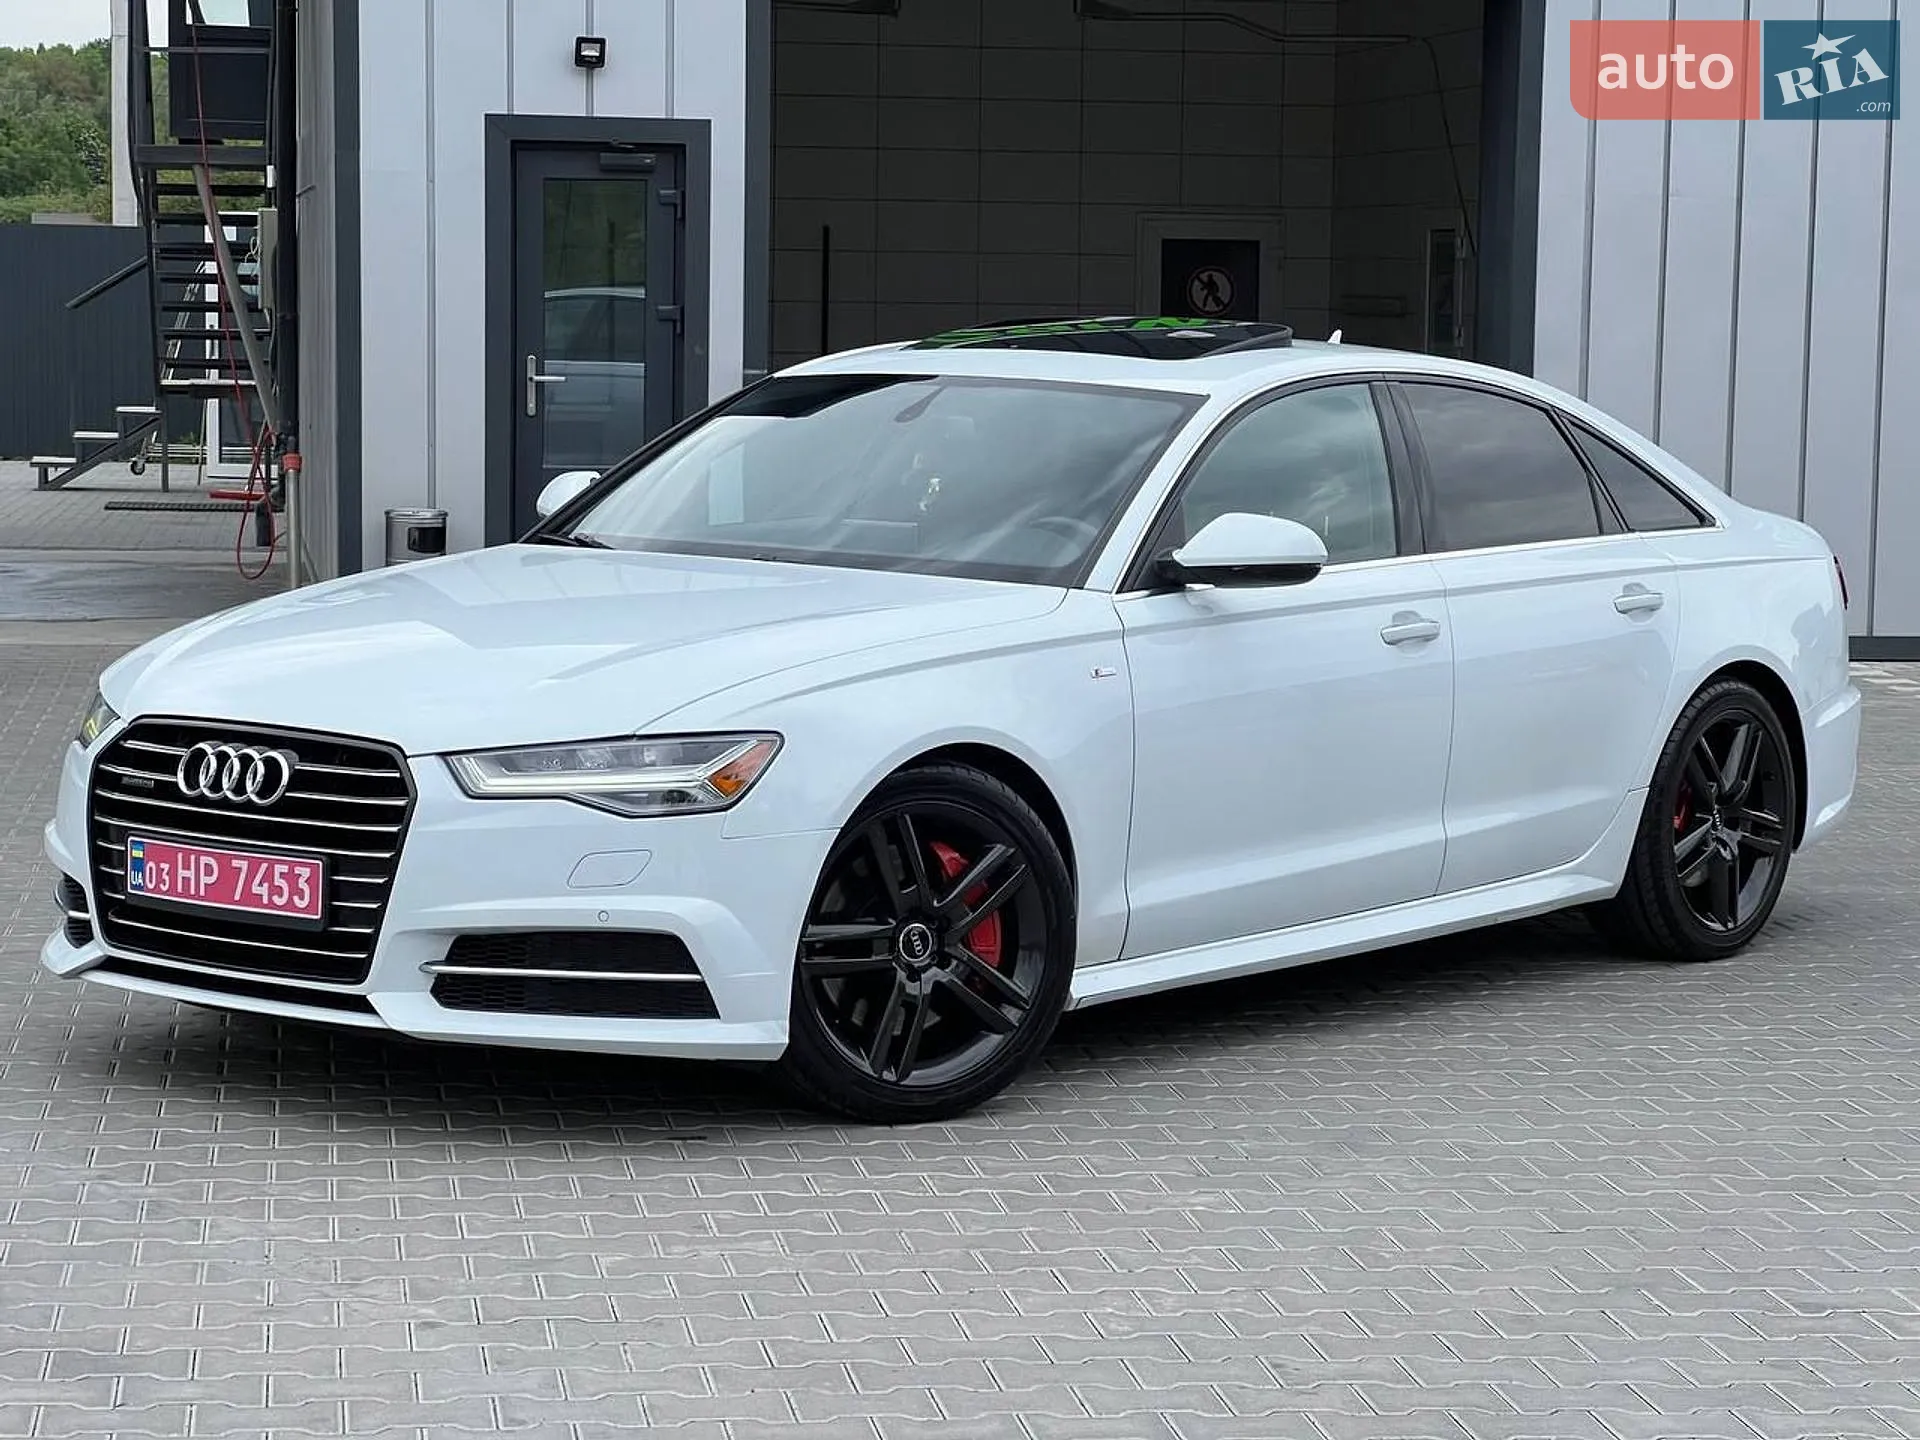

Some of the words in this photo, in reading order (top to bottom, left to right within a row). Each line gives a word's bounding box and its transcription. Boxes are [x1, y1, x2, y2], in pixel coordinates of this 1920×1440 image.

[130, 870, 144, 886] UA
[145, 861, 170, 892] 03
[177, 852, 219, 897] HP
[231, 859, 312, 909] 7453
